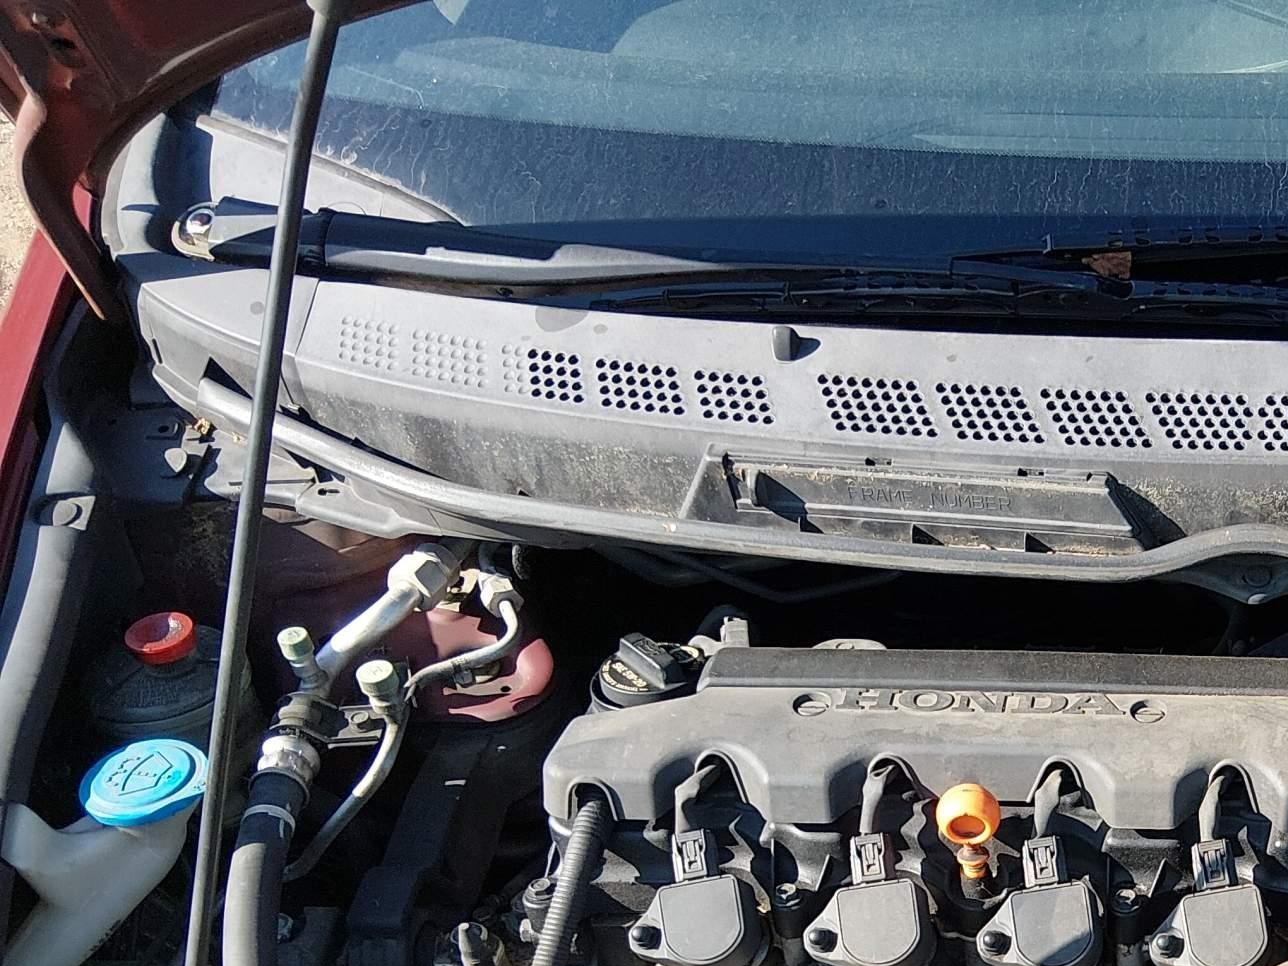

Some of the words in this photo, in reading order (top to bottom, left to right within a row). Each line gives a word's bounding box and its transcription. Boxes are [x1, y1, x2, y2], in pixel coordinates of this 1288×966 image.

[847, 486, 913, 504] FRAME
[930, 492, 1012, 512] NUMBER
[834, 686, 1126, 715] HONDA
